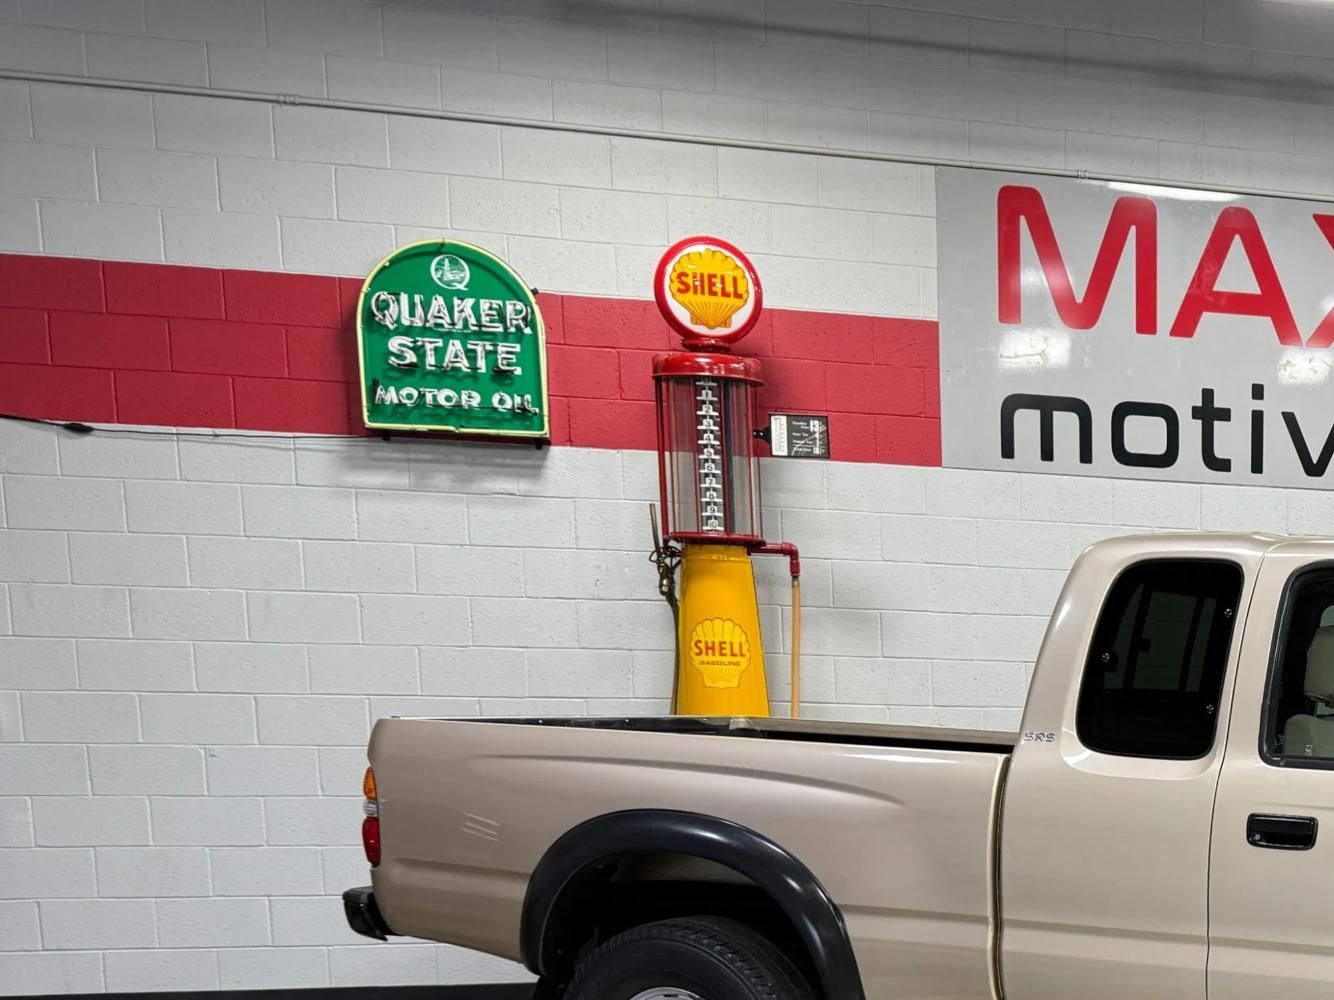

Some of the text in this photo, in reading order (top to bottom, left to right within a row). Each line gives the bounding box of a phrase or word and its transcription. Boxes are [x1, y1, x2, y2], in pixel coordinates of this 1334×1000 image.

[676, 271, 744, 300] SHELL
[371, 291, 533, 334] QUAKER
[388, 336, 523, 375] STATE
[375, 385, 481, 408] MOTOR
[694, 639, 746, 657] SHELL
